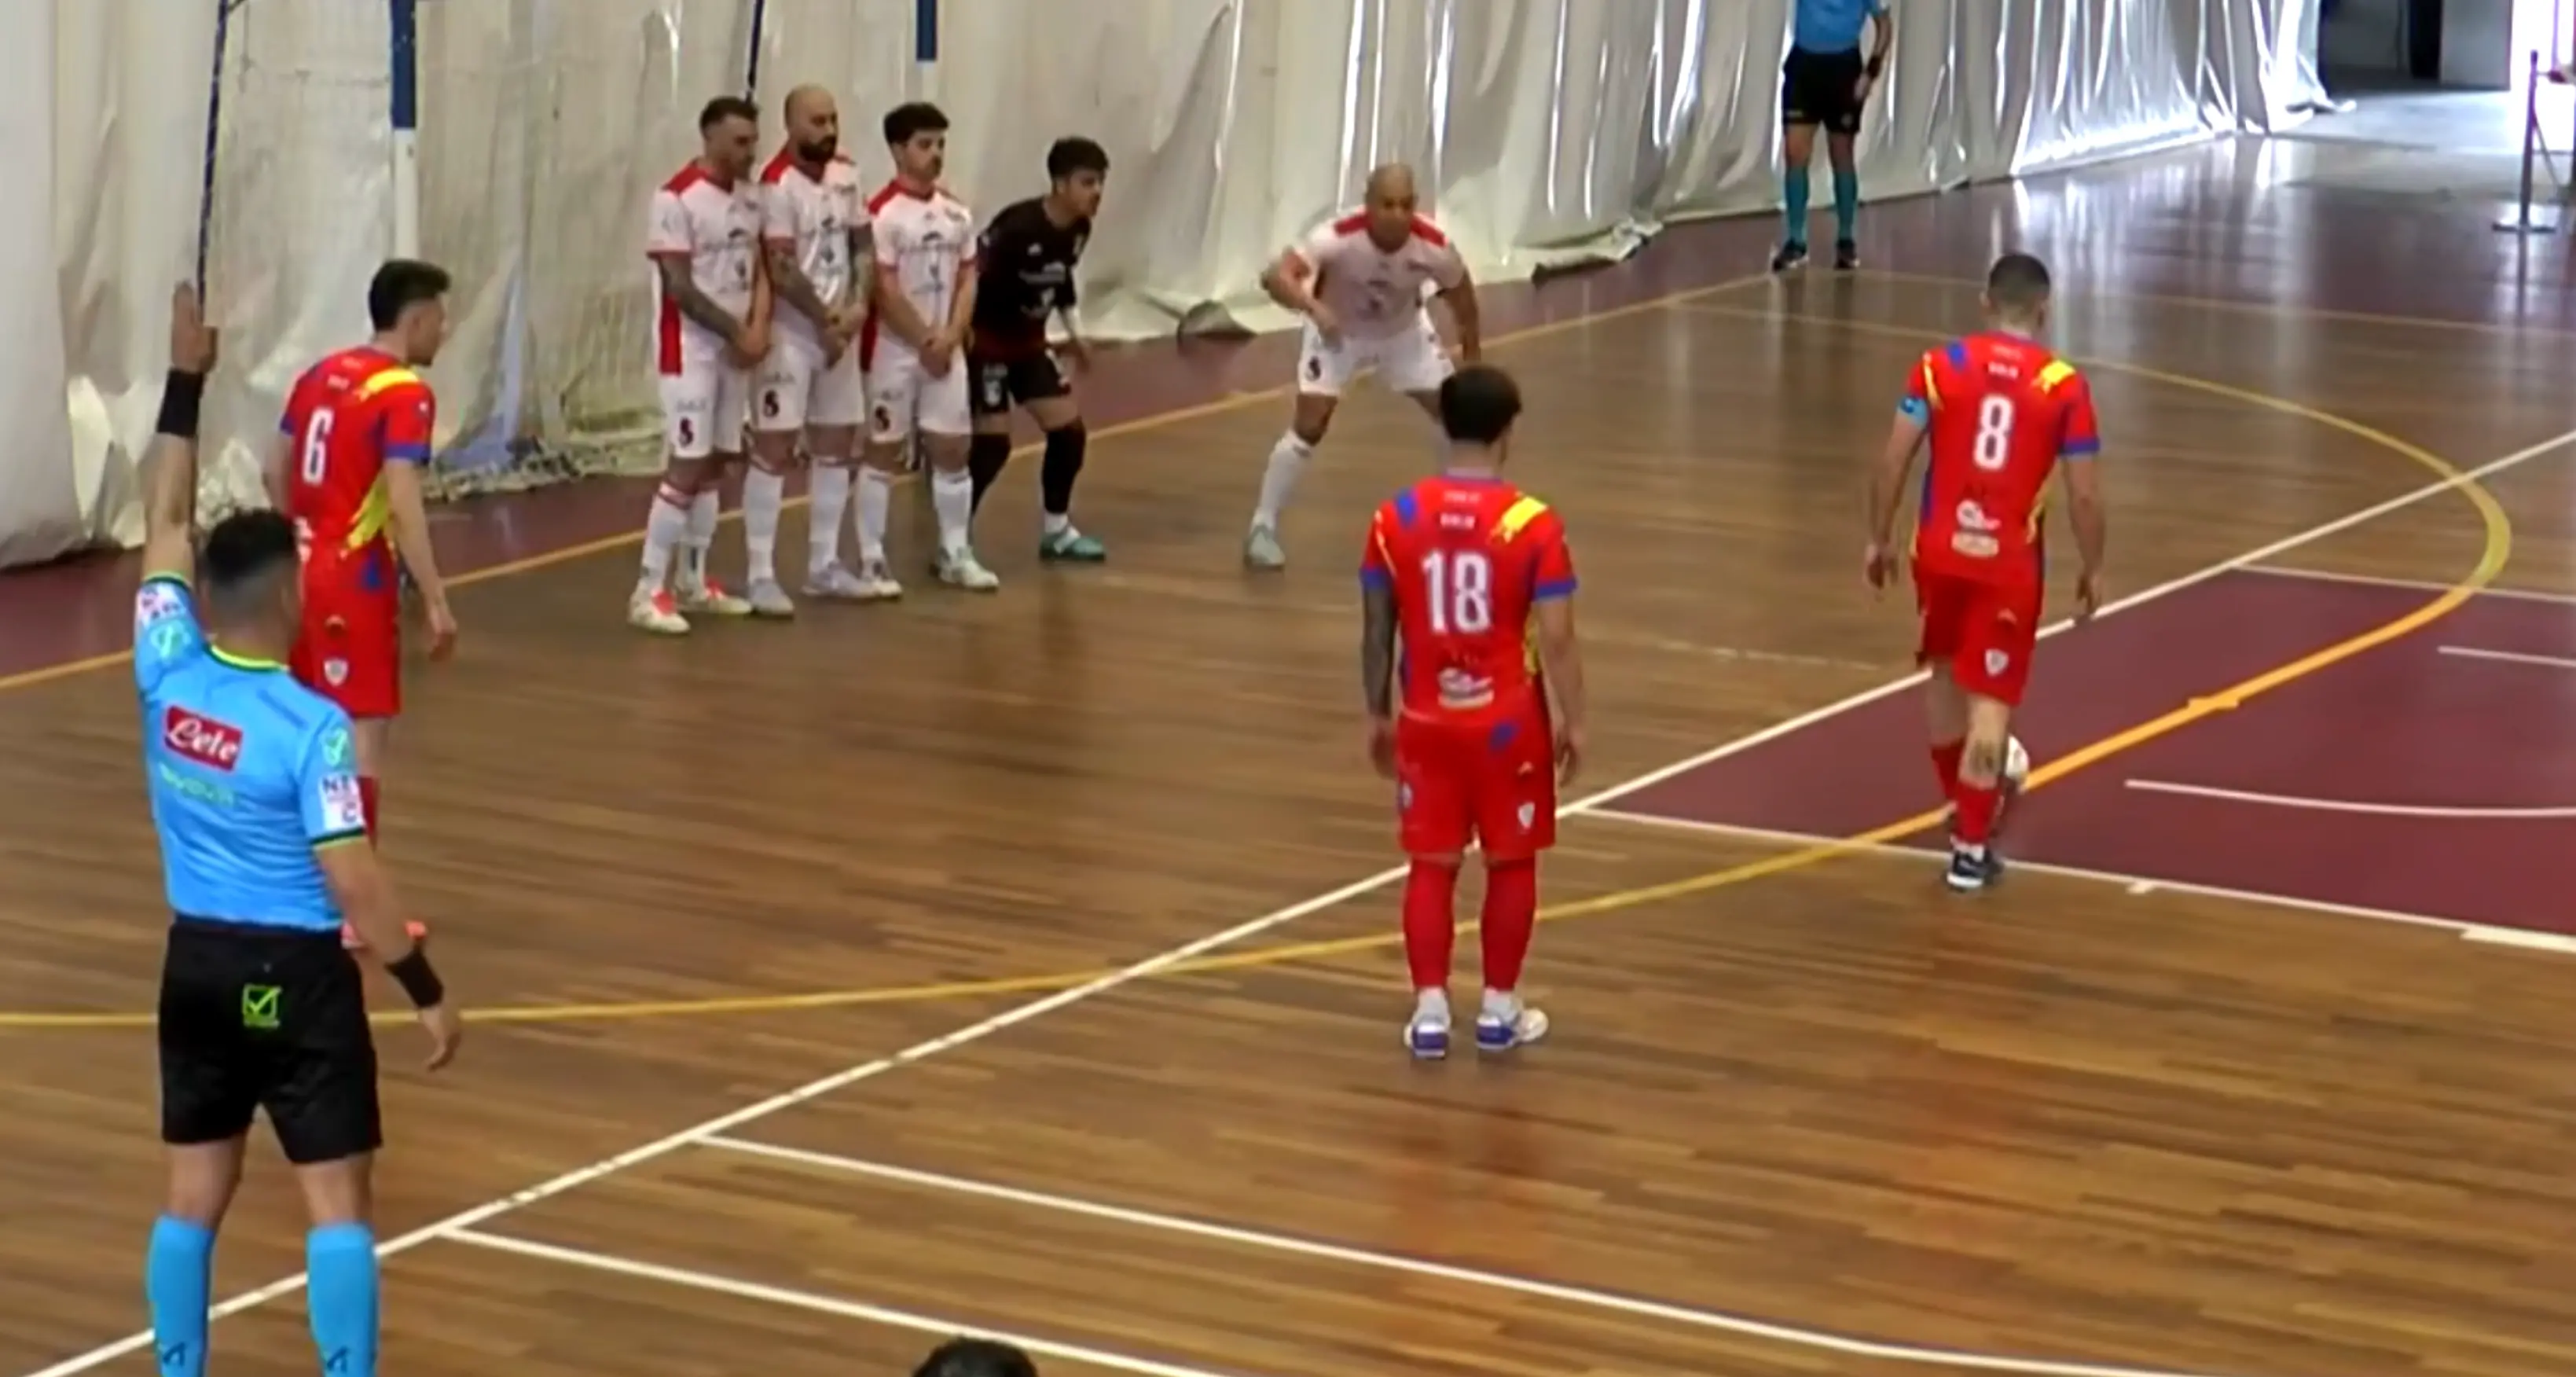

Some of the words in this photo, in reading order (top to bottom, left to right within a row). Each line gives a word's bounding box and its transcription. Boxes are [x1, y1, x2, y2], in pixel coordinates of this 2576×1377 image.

[302, 406, 335, 485] 6
[1973, 393, 2013, 471] 8
[1421, 549, 1492, 633] 18
